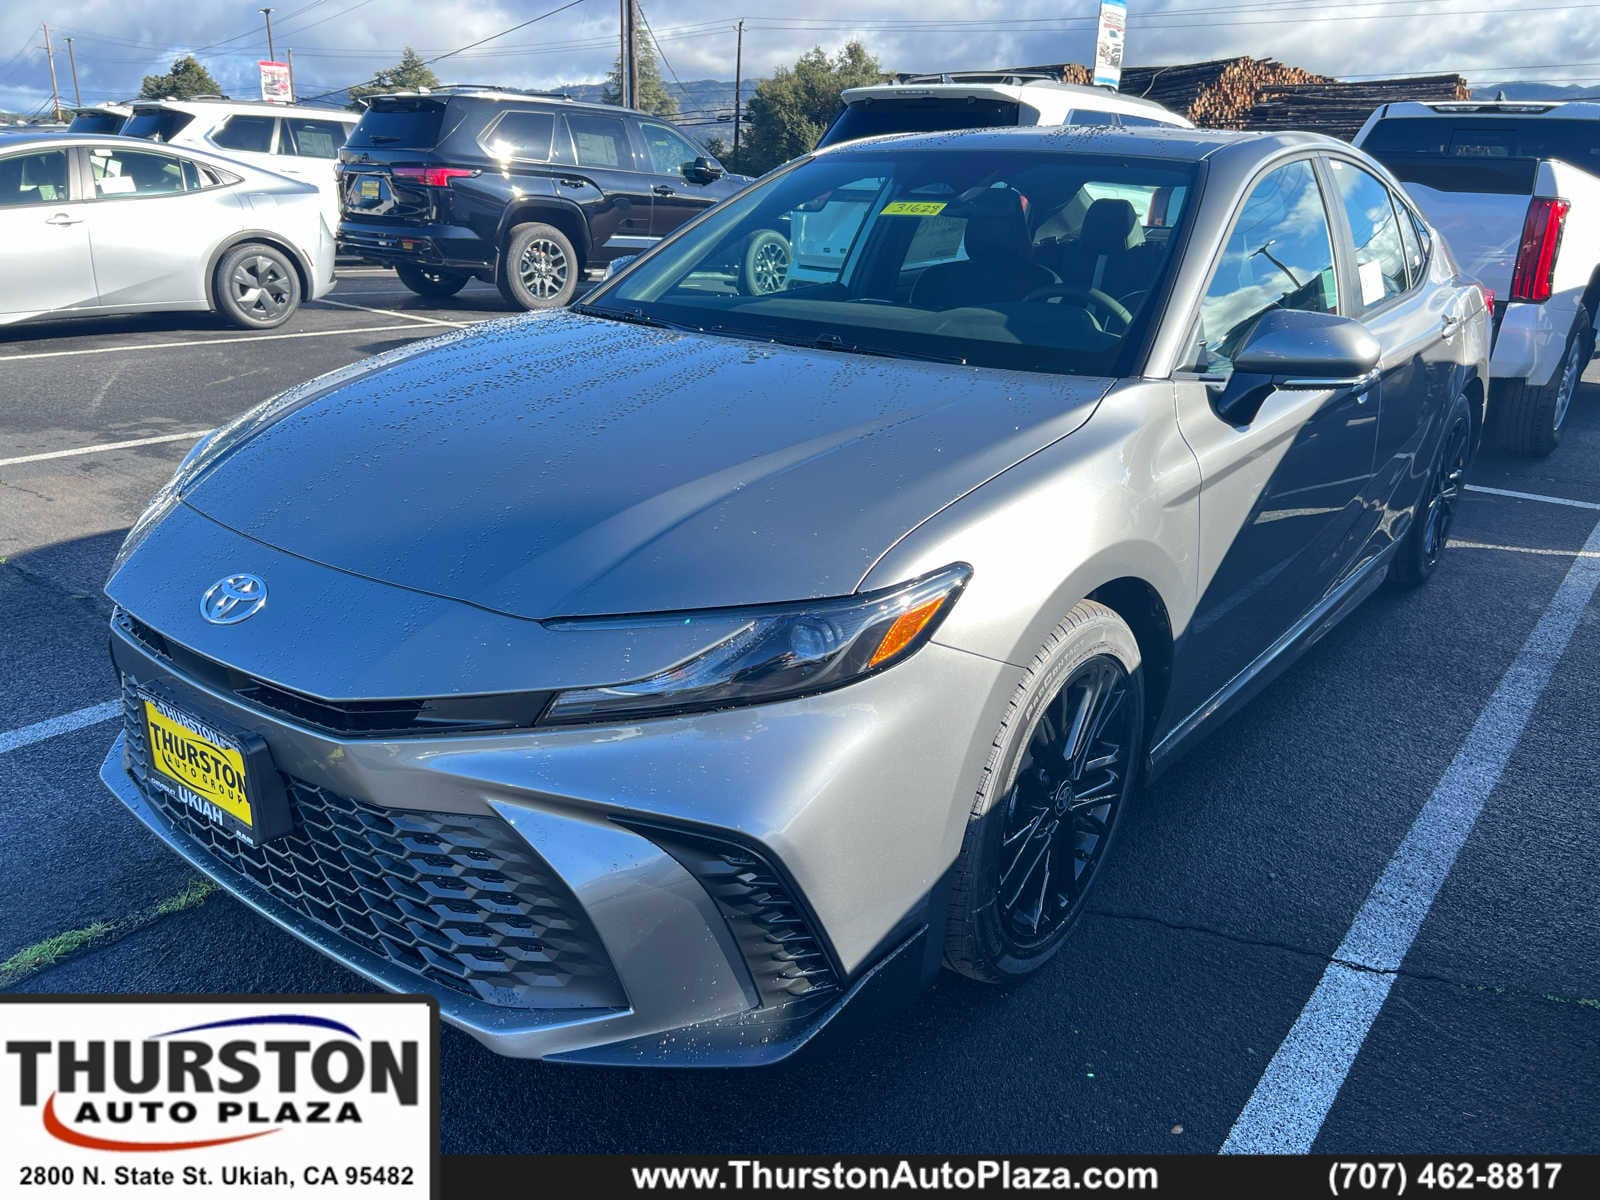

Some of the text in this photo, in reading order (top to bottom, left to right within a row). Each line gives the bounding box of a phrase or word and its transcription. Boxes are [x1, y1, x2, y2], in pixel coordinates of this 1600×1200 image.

[158, 701, 221, 746] THURSTON
[150, 721, 247, 795] THURSTON
[167, 753, 243, 804] AUTO GROUP
[178, 785, 223, 827] UKIAH
